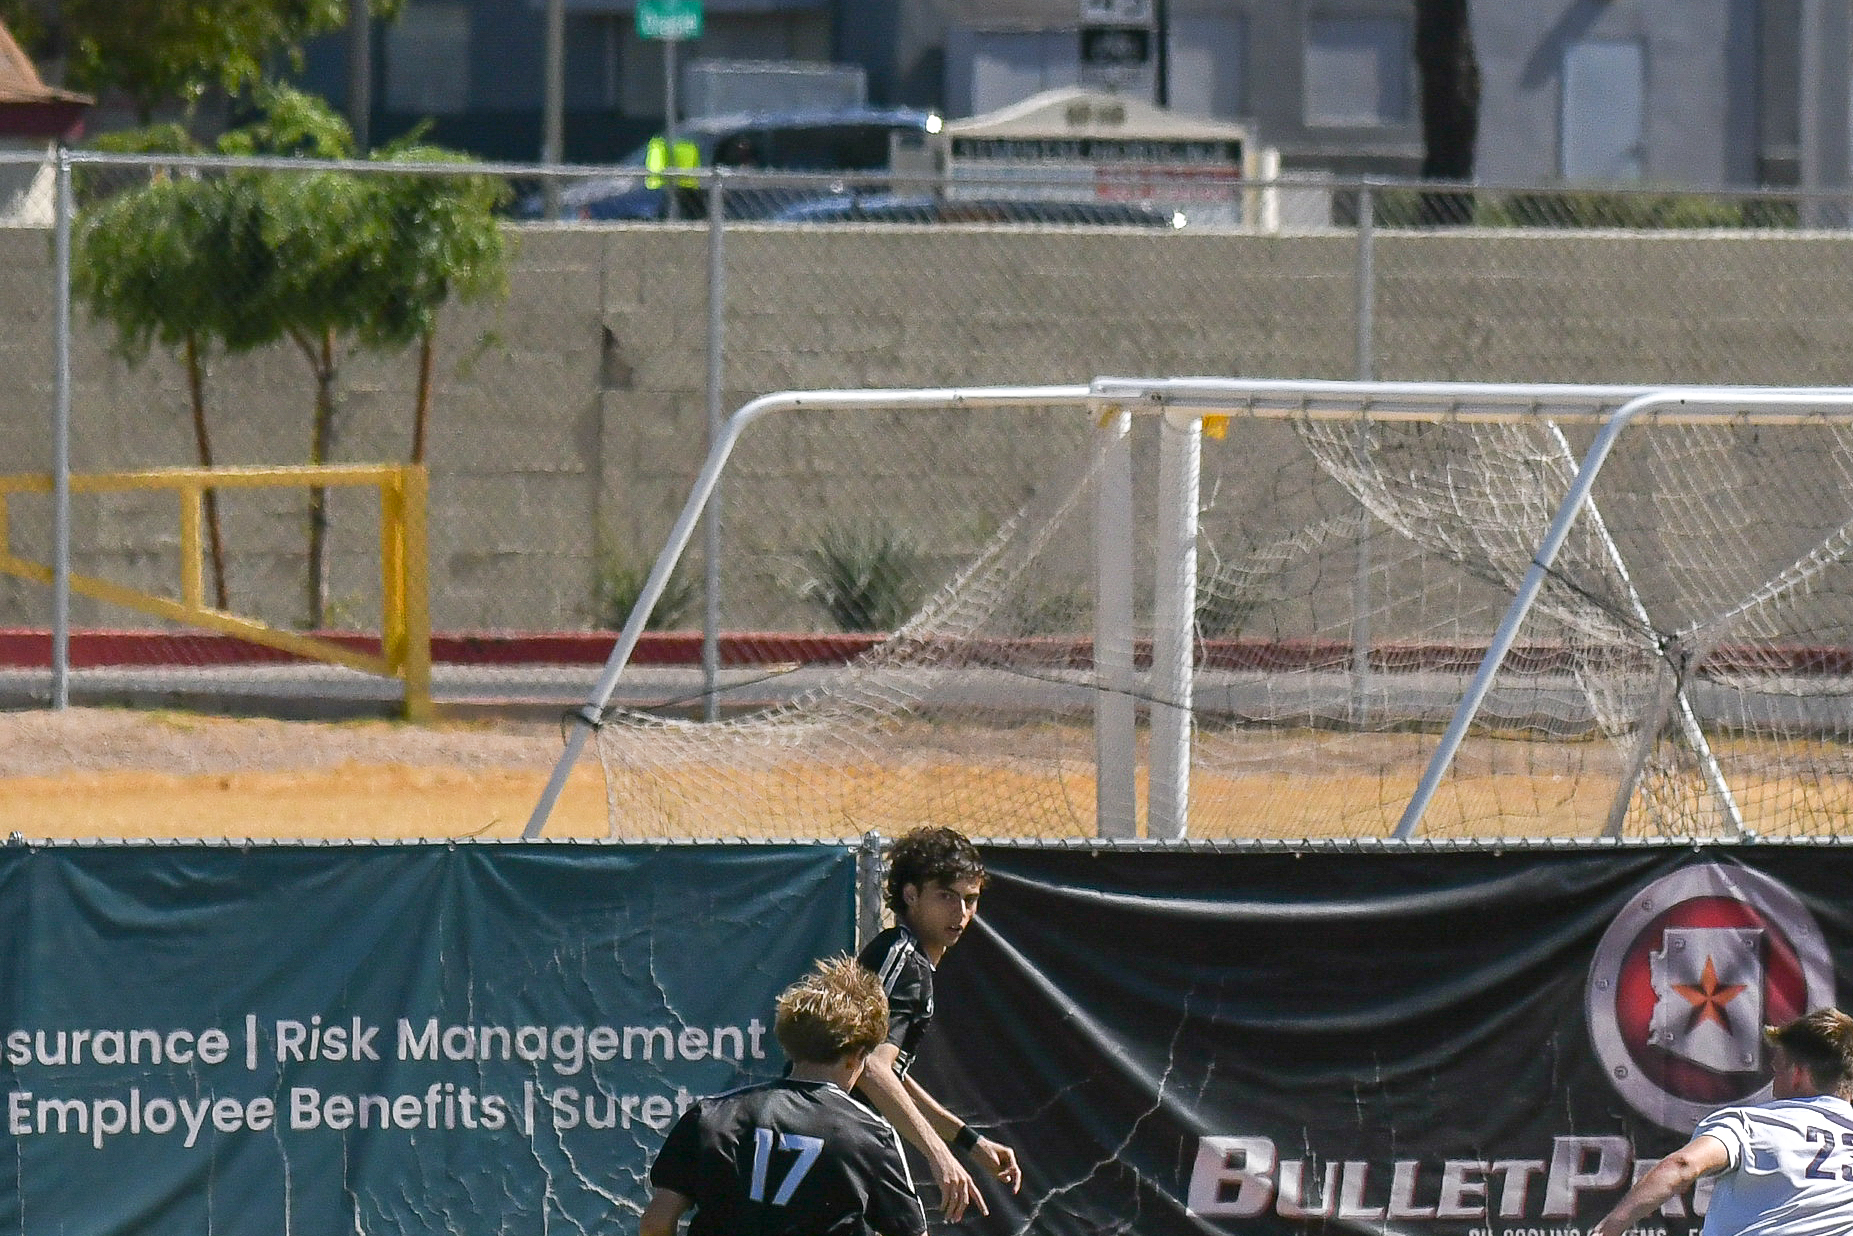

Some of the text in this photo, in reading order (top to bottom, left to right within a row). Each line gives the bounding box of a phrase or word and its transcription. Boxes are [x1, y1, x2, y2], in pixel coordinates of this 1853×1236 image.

[0, 1029, 230, 1066] surance
[276, 1014, 381, 1063] Risk
[397, 1017, 767, 1075] Management
[8, 1087, 275, 1150] Employee
[290, 1082, 506, 1131] Benefits
[553, 1085, 703, 1130] Suret
[750, 1128, 825, 1206] 17
